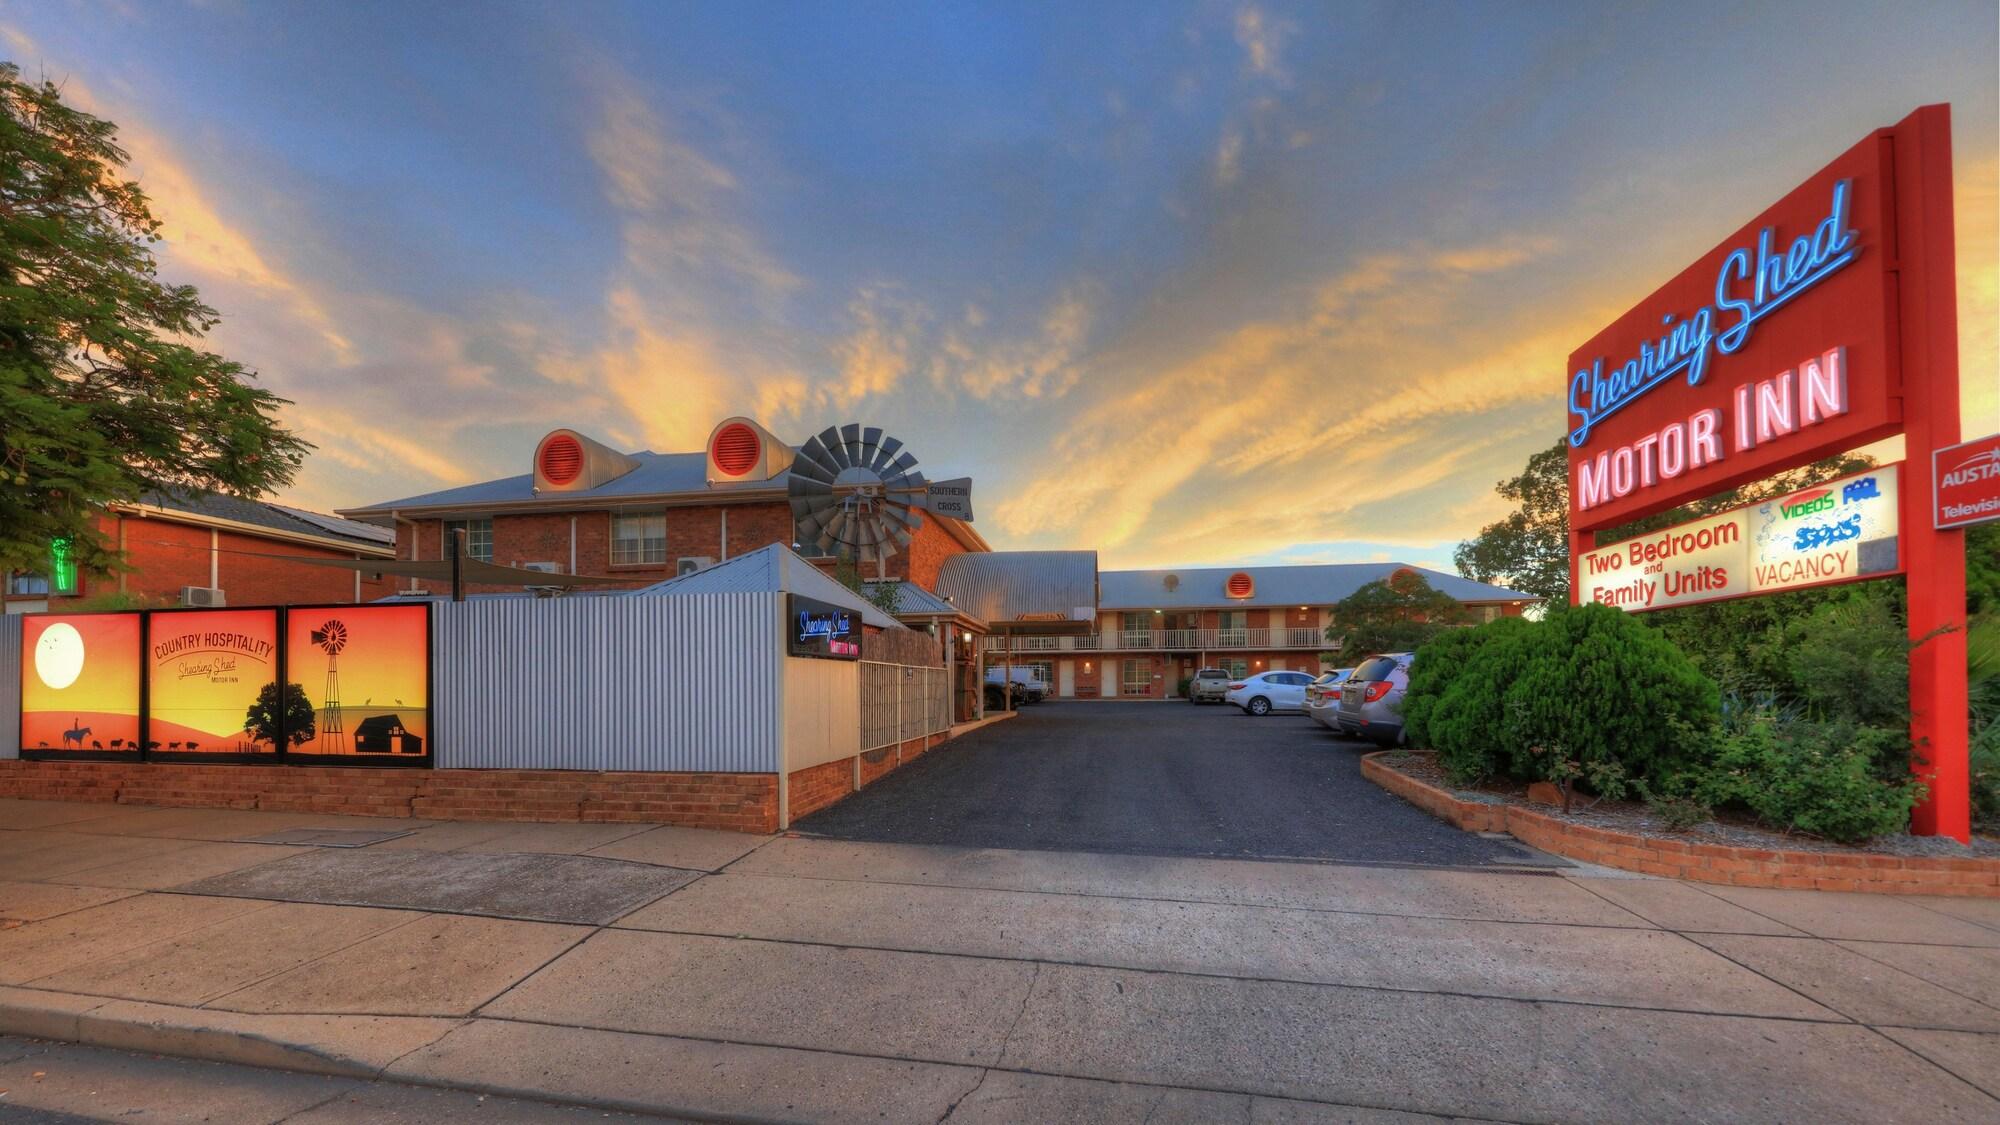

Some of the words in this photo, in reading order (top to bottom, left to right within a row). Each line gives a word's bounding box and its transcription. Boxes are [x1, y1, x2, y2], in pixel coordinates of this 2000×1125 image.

[1569, 304, 1718, 447] Shearing
[1715, 178, 1863, 354] Shed
[1577, 407, 1725, 512] MOTOR
[1733, 345, 1848, 452] INN
[930, 486, 968, 497] SOUTHERN
[937, 501, 962, 511] CROSS
[1780, 490, 1834, 520] VIDEOS
[1941, 496, 2000, 518] Televisi
[1585, 552, 1622, 575] Two
[1629, 521, 1738, 566] Bedroom
[1644, 561, 1663, 575] and
[1755, 550, 1849, 586] VACANCY
[1593, 578, 1656, 607] Family
[1664, 565, 1729, 597] Units
[800, 609, 832, 643] Shearing
[831, 607, 850, 639] Shed
[154, 634, 201, 660] COUNTRY
[204, 632, 274, 658] HOSPITALITY
[178, 660, 213, 680] Shearing
[213, 656, 237, 675] Shed
